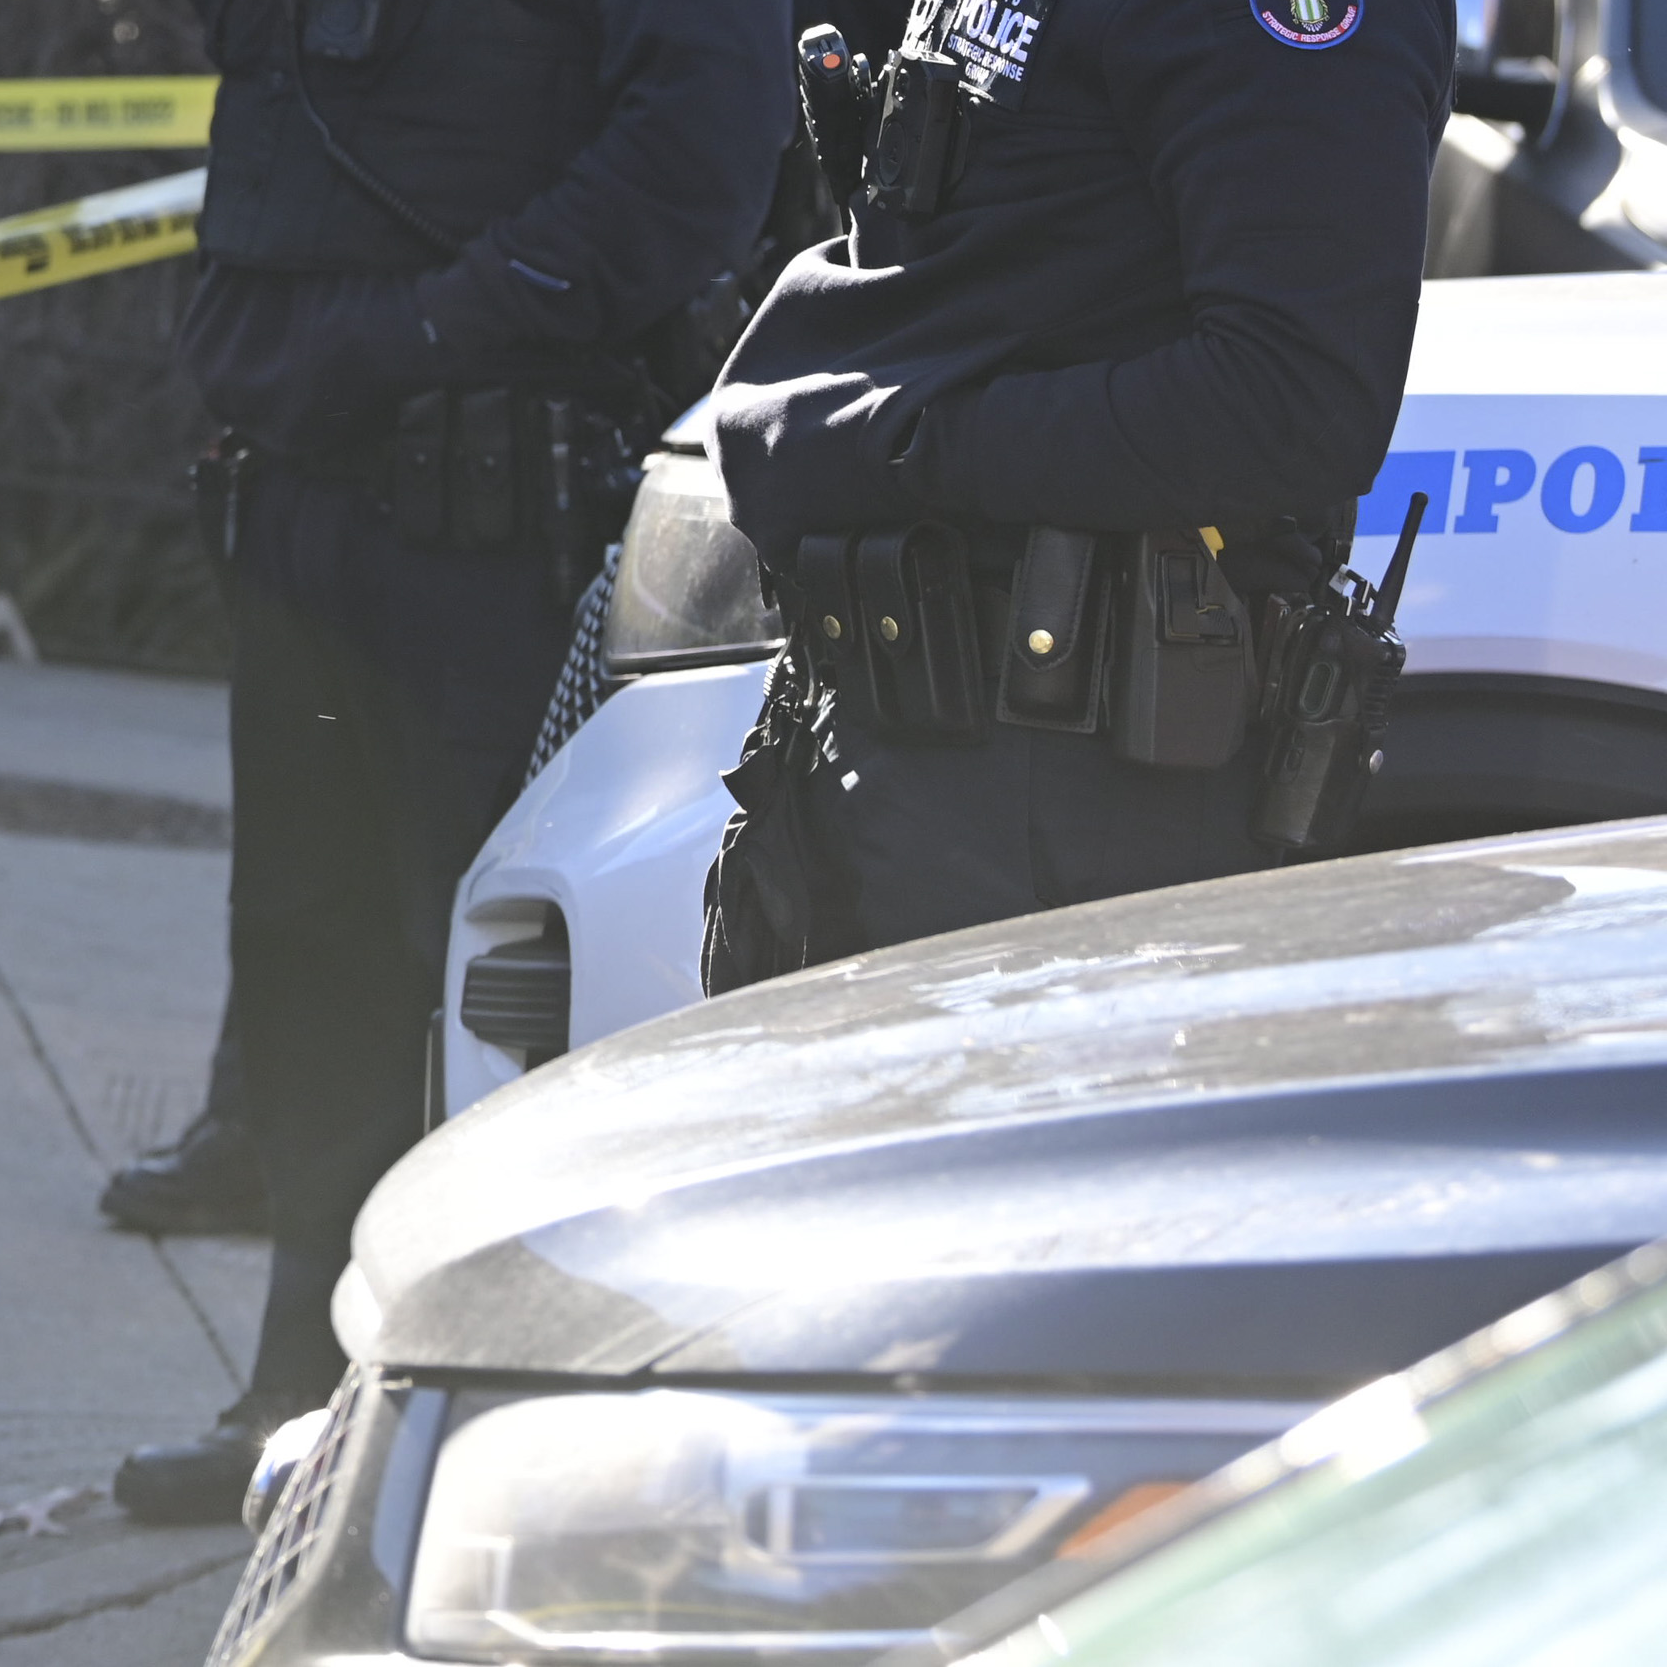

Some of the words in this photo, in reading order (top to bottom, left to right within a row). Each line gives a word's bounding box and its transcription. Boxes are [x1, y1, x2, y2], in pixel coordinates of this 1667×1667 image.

[1262, 11, 1298, 41] STRATEGIC
[1300, 28, 1341, 42] RESPONSE
[1340, 6, 1357, 30] GROUP
[948, 34, 984, 63] STRATEGIC
